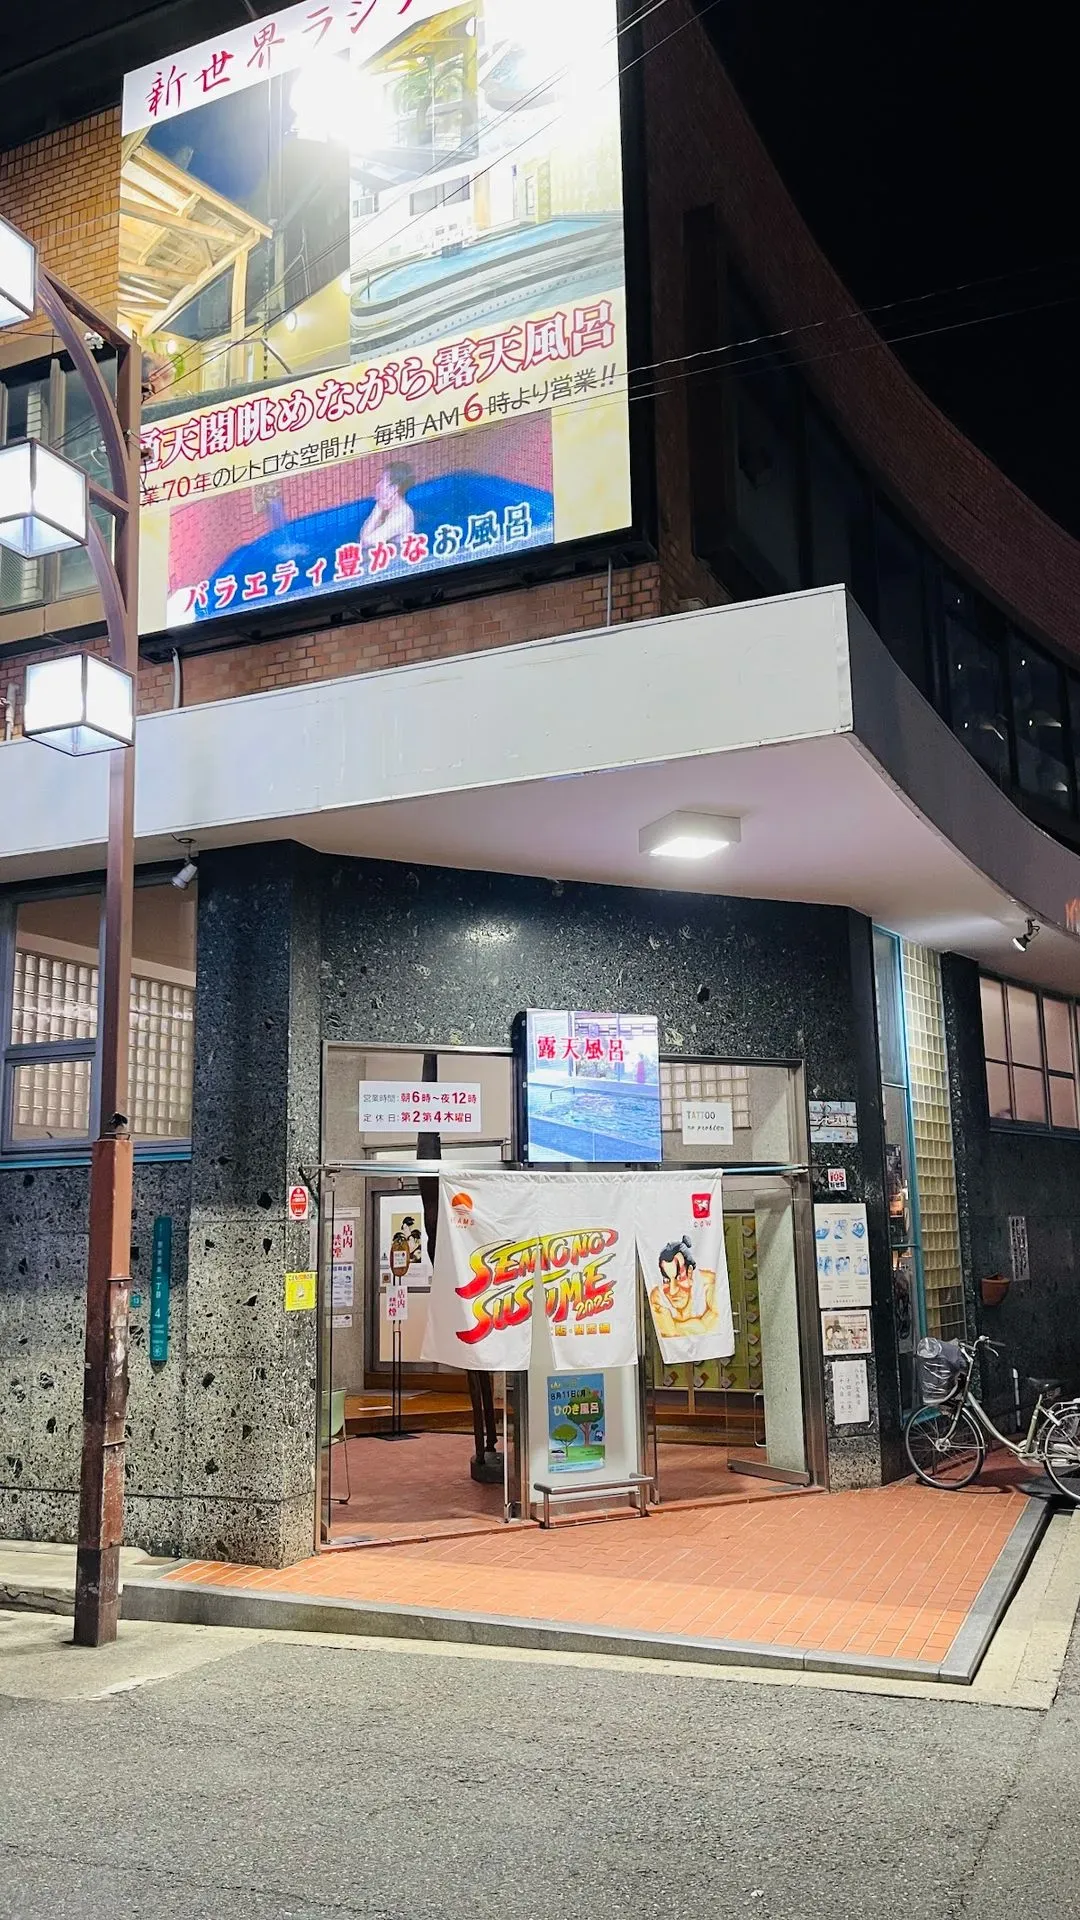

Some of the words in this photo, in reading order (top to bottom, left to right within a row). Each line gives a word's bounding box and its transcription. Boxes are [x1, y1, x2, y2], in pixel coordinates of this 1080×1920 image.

[185, 503, 533, 615] バラエティ豊かなお風呂
[536, 1036, 625, 1062] 露天風呂
[686, 1110, 716, 1120] TATTOO
[343, 1224, 353, 1248] 店内
[154, 1308, 161, 1318] 4
[575, 1291, 615, 1321] 2025
[553, 1402, 600, 1416] ひのき風呂
